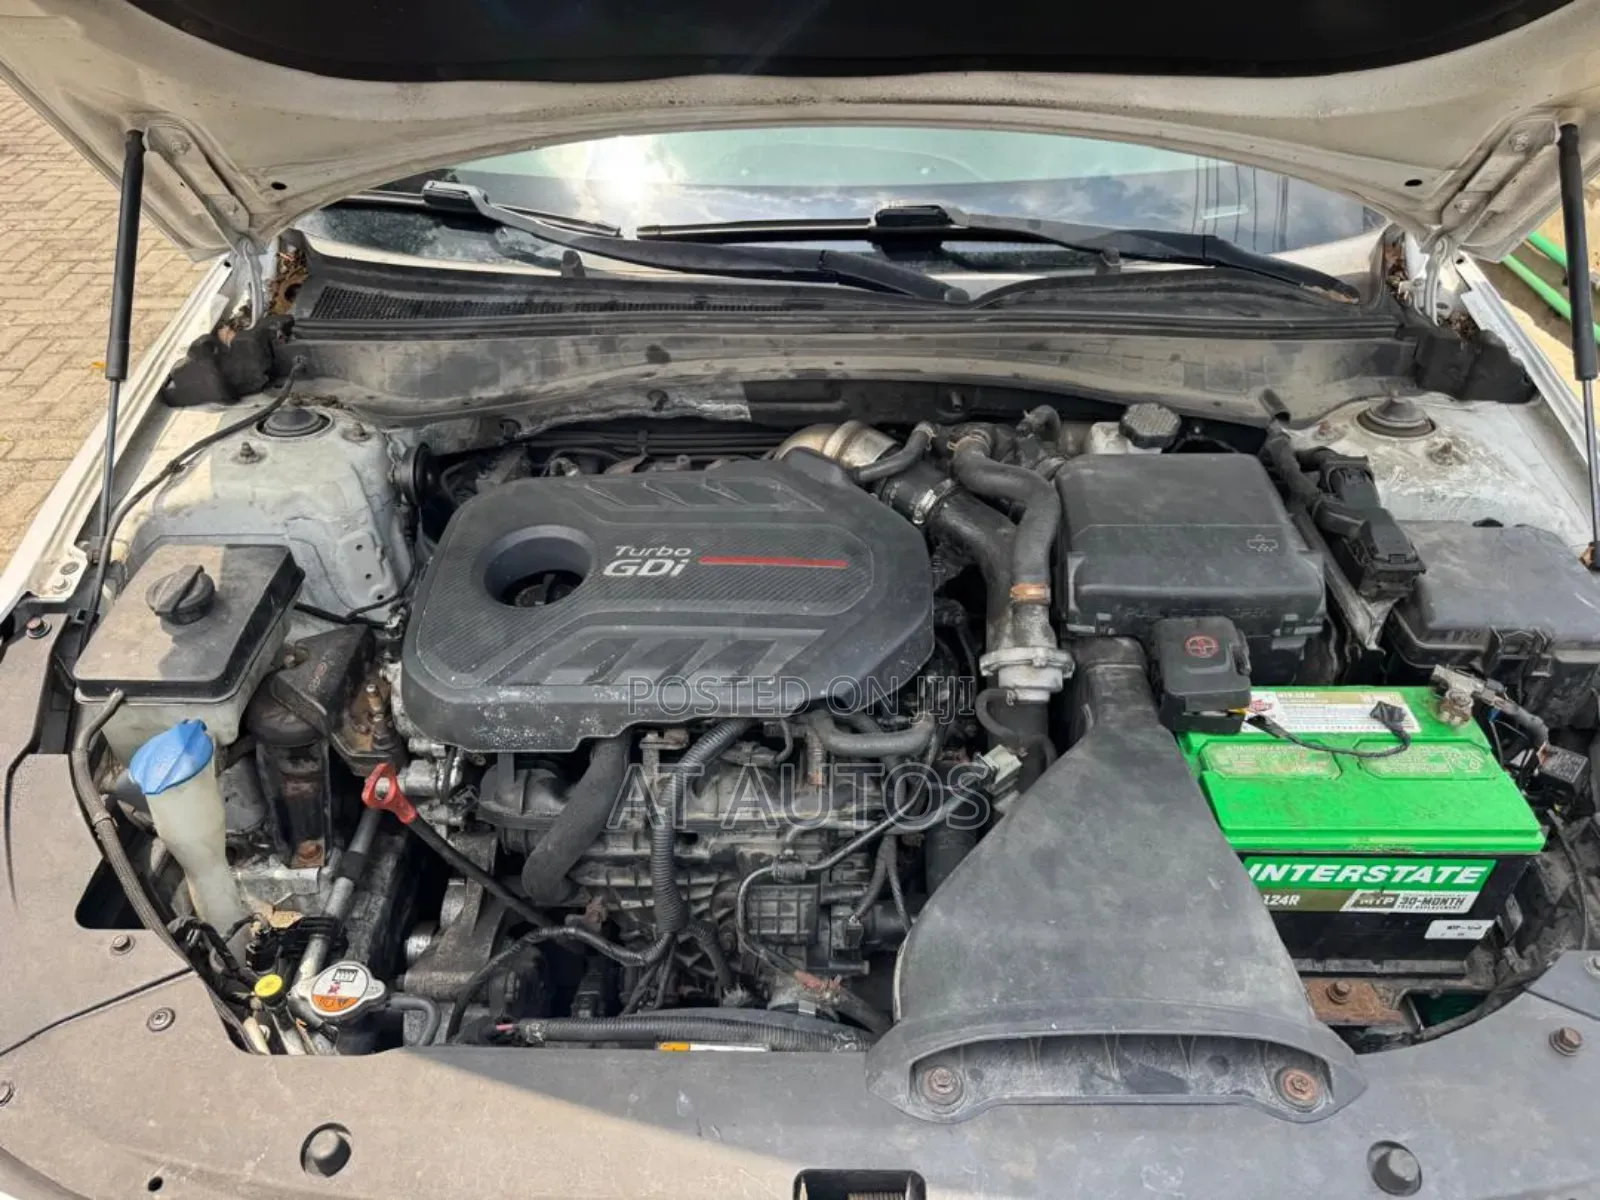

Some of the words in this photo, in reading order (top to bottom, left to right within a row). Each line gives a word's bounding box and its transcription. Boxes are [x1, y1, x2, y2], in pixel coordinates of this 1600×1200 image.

[614, 545, 692, 557] Turbo
[603, 557, 690, 577] GDi
[1248, 863, 1488, 884] INTERSTATE
[1400, 896, 1466, 906] 30-MONTH
